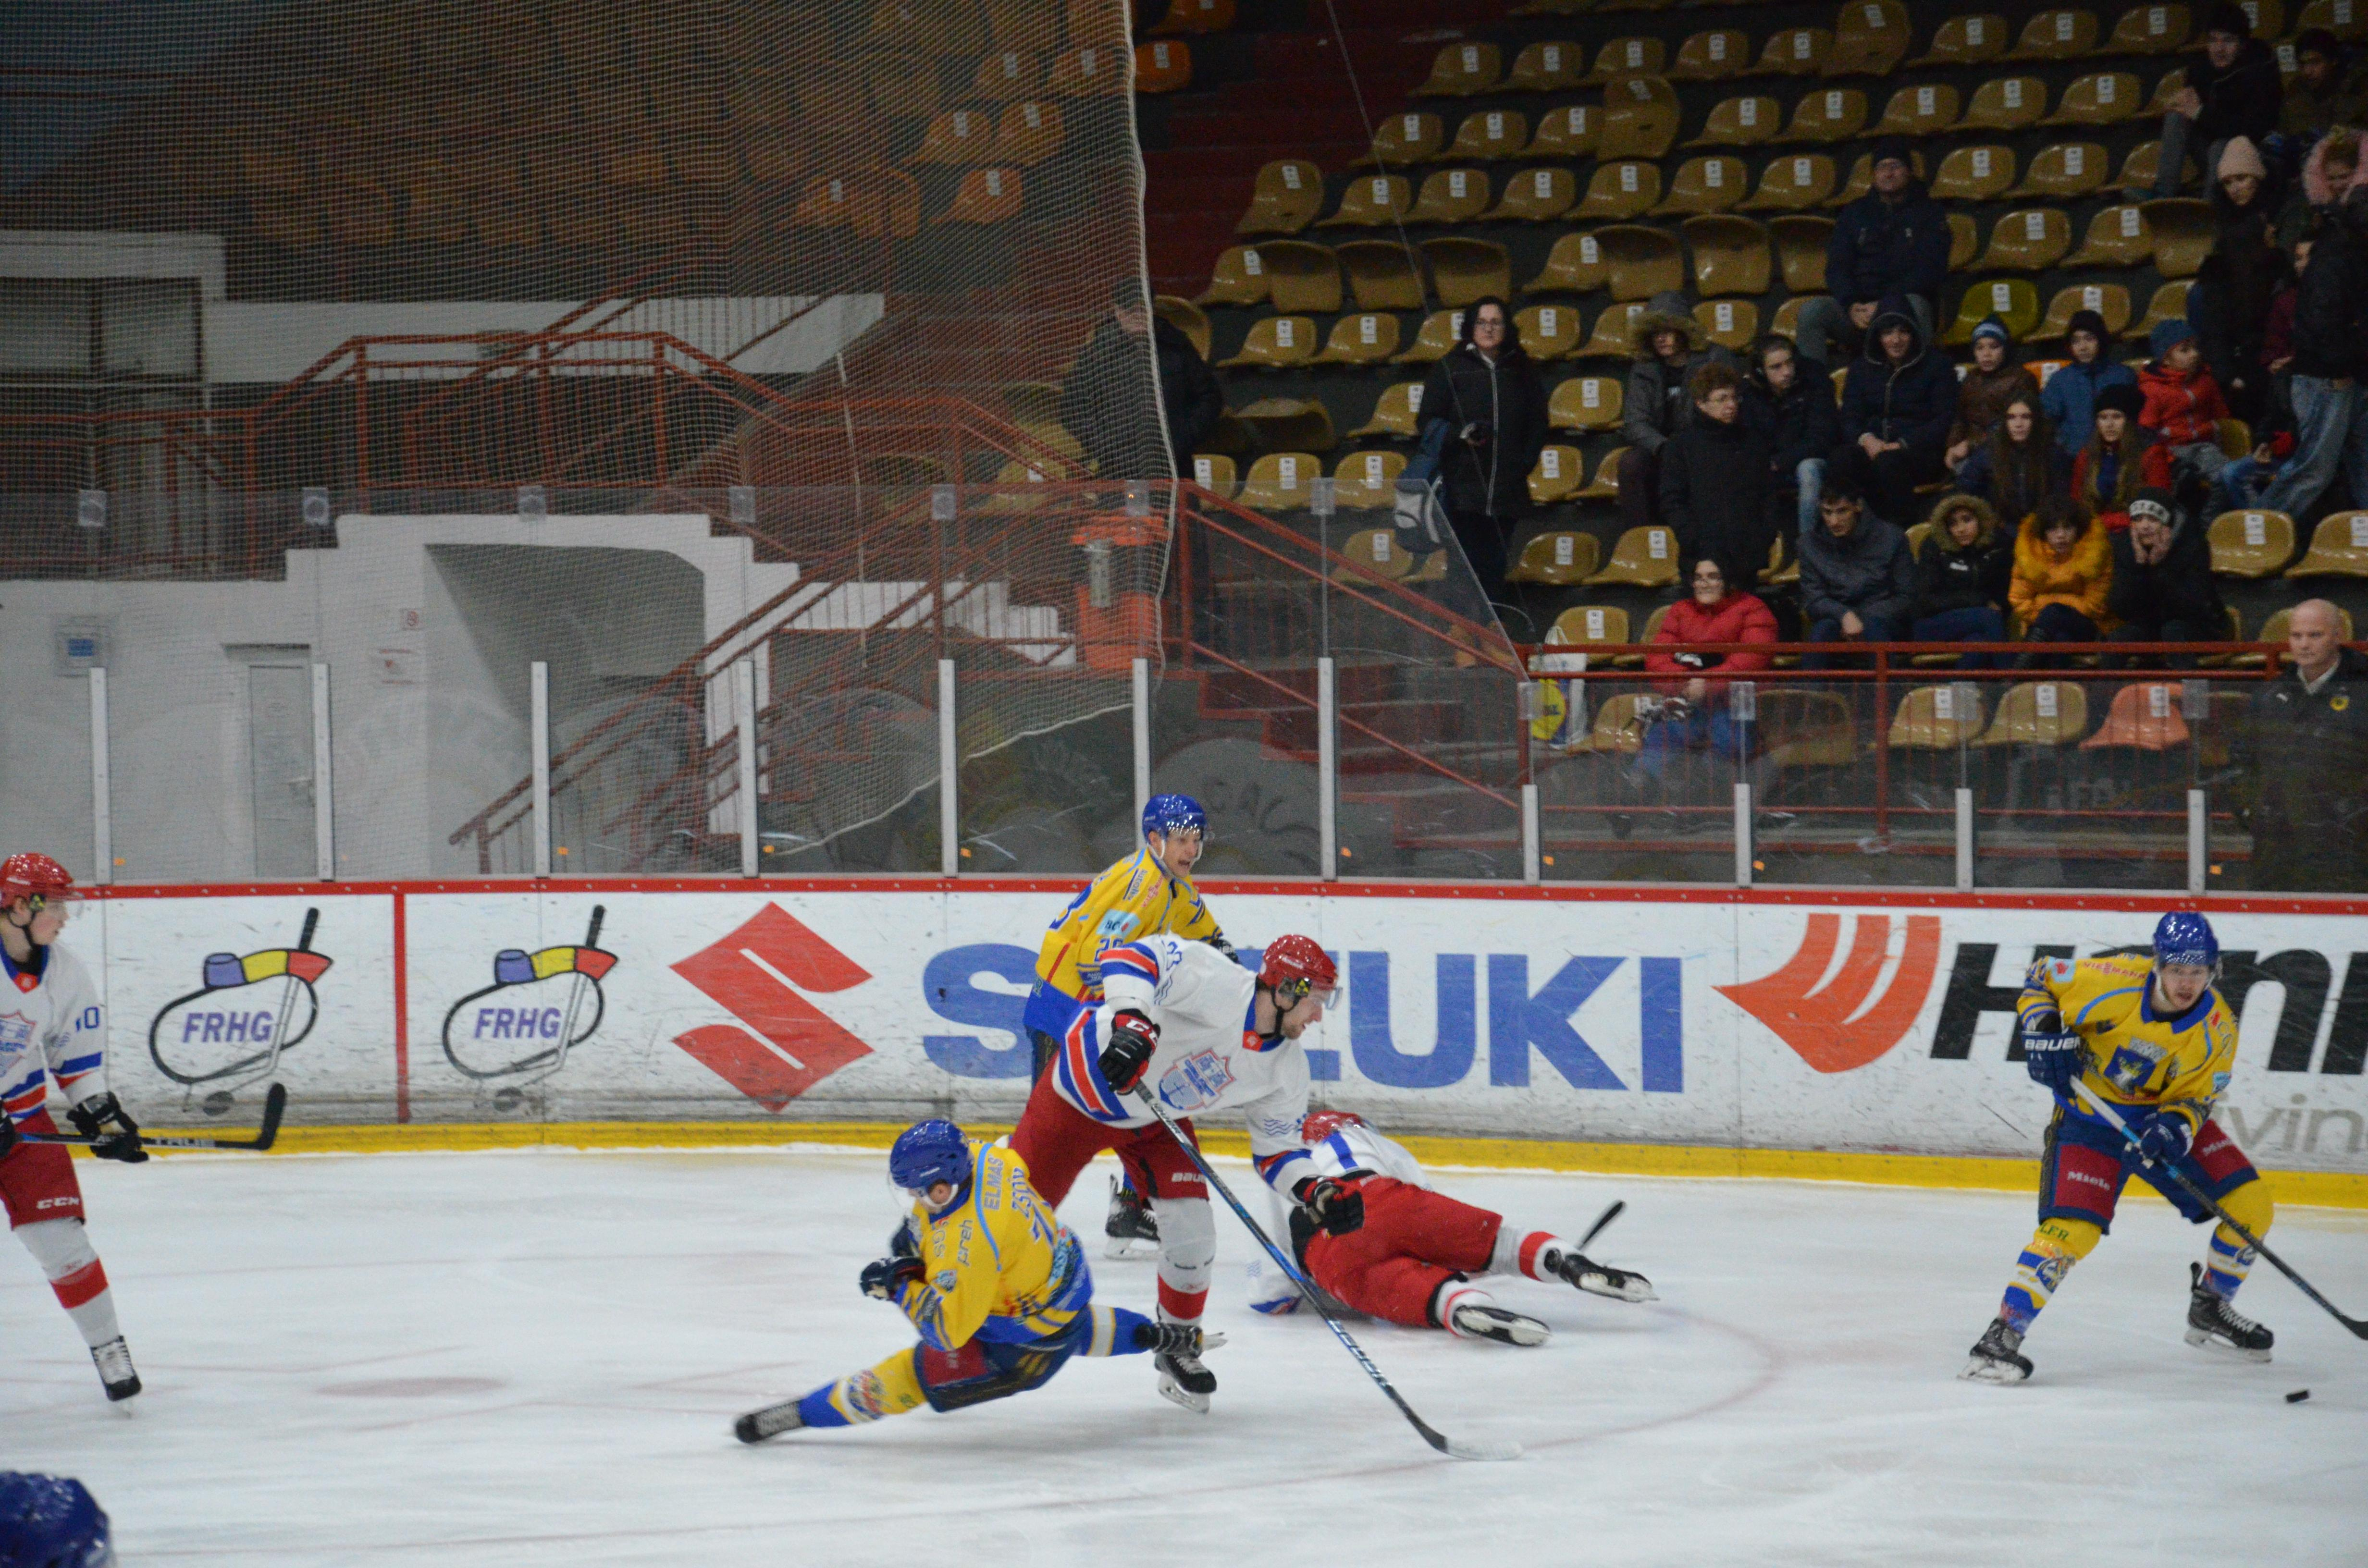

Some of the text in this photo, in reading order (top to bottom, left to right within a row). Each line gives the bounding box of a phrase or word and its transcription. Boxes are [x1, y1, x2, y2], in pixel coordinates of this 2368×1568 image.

[182, 1011, 274, 1044] FRHG
[473, 1007, 562, 1040] FRHG
[923, 942, 1684, 1094] SUKI
[1126, 1019, 1158, 1047] CC
[984, 1154, 1004, 1210] ELMAS
[2067, 1171, 2110, 1190] Miele
[957, 1219, 974, 1267] preh
